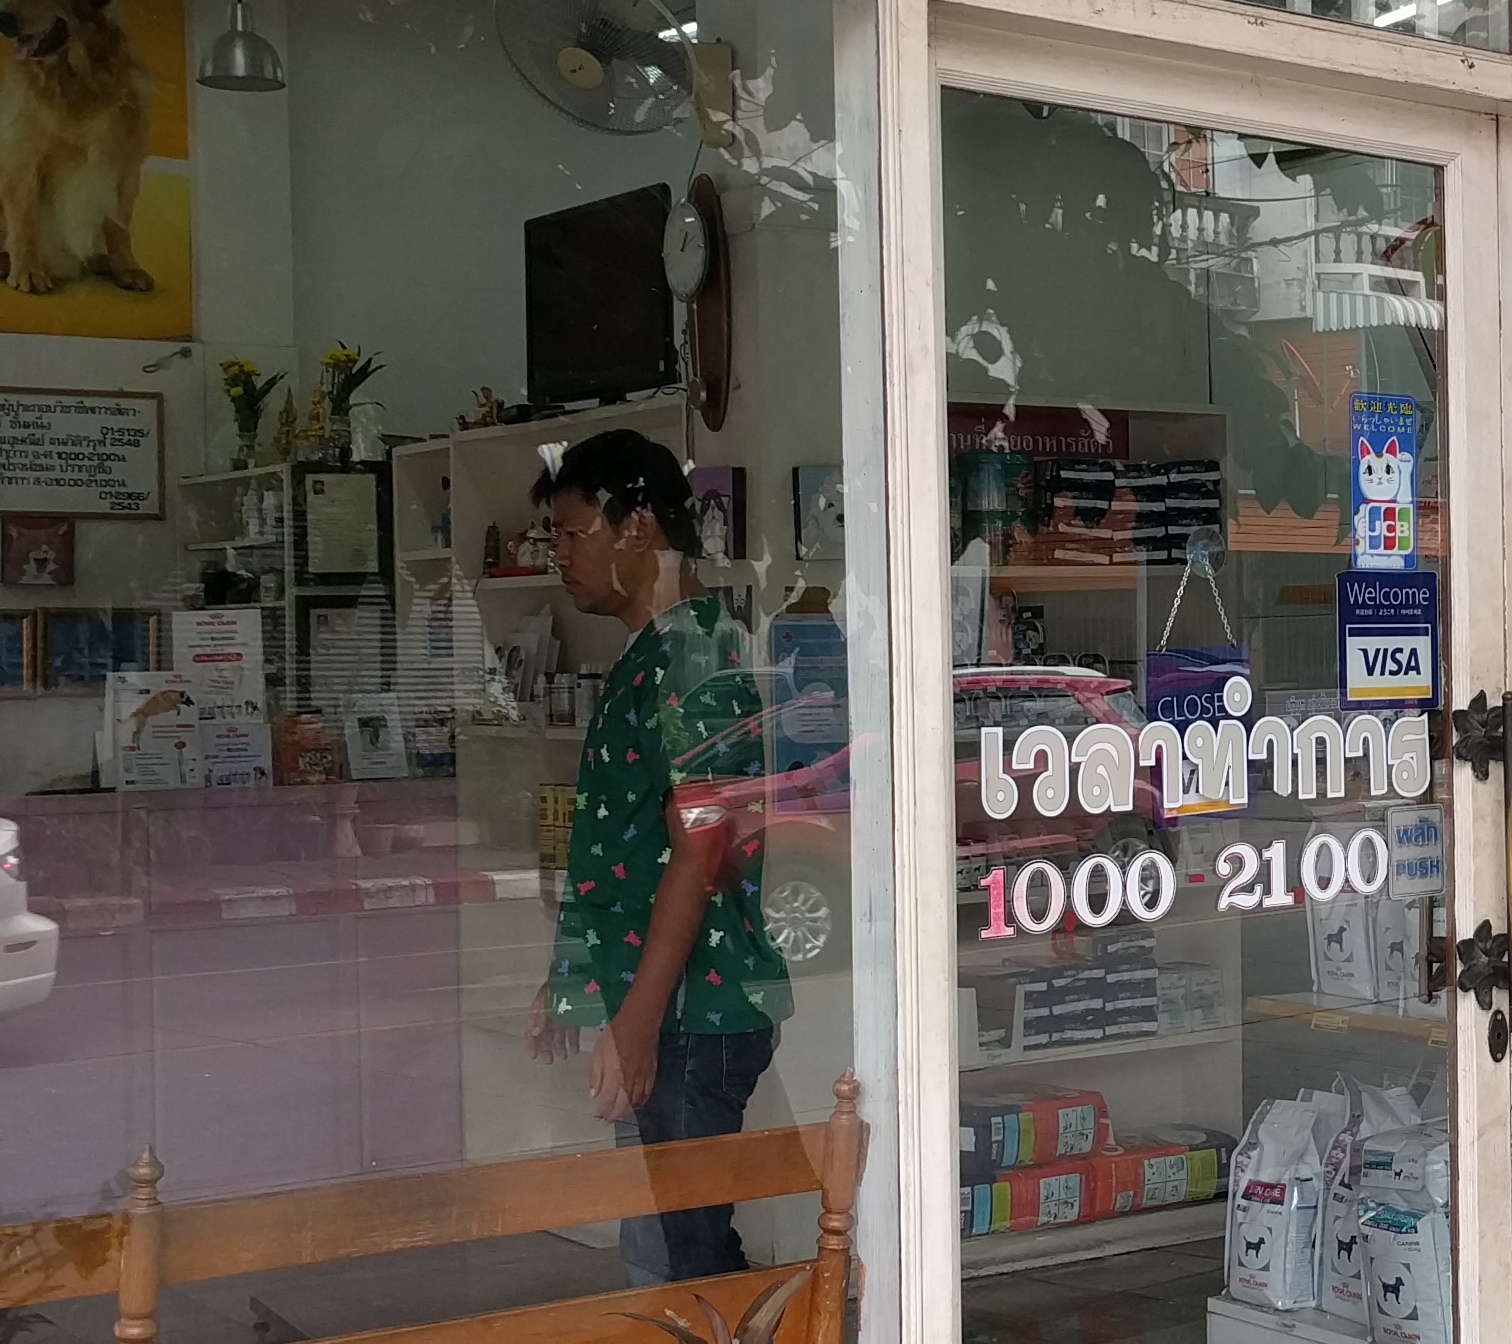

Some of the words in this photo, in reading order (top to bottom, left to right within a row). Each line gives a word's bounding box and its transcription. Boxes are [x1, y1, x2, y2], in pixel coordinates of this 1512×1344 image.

[1353, 424, 1413, 434] WELCOME
[1368, 519, 1411, 538] JCB
[1346, 581, 1430, 606] Welcome
[1357, 647, 1422, 677] VISA
[1158, 692, 1225, 721] CLOSE
[980, 675, 1431, 819] เวลาทำการ
[1394, 858, 1440, 879] PUSH
